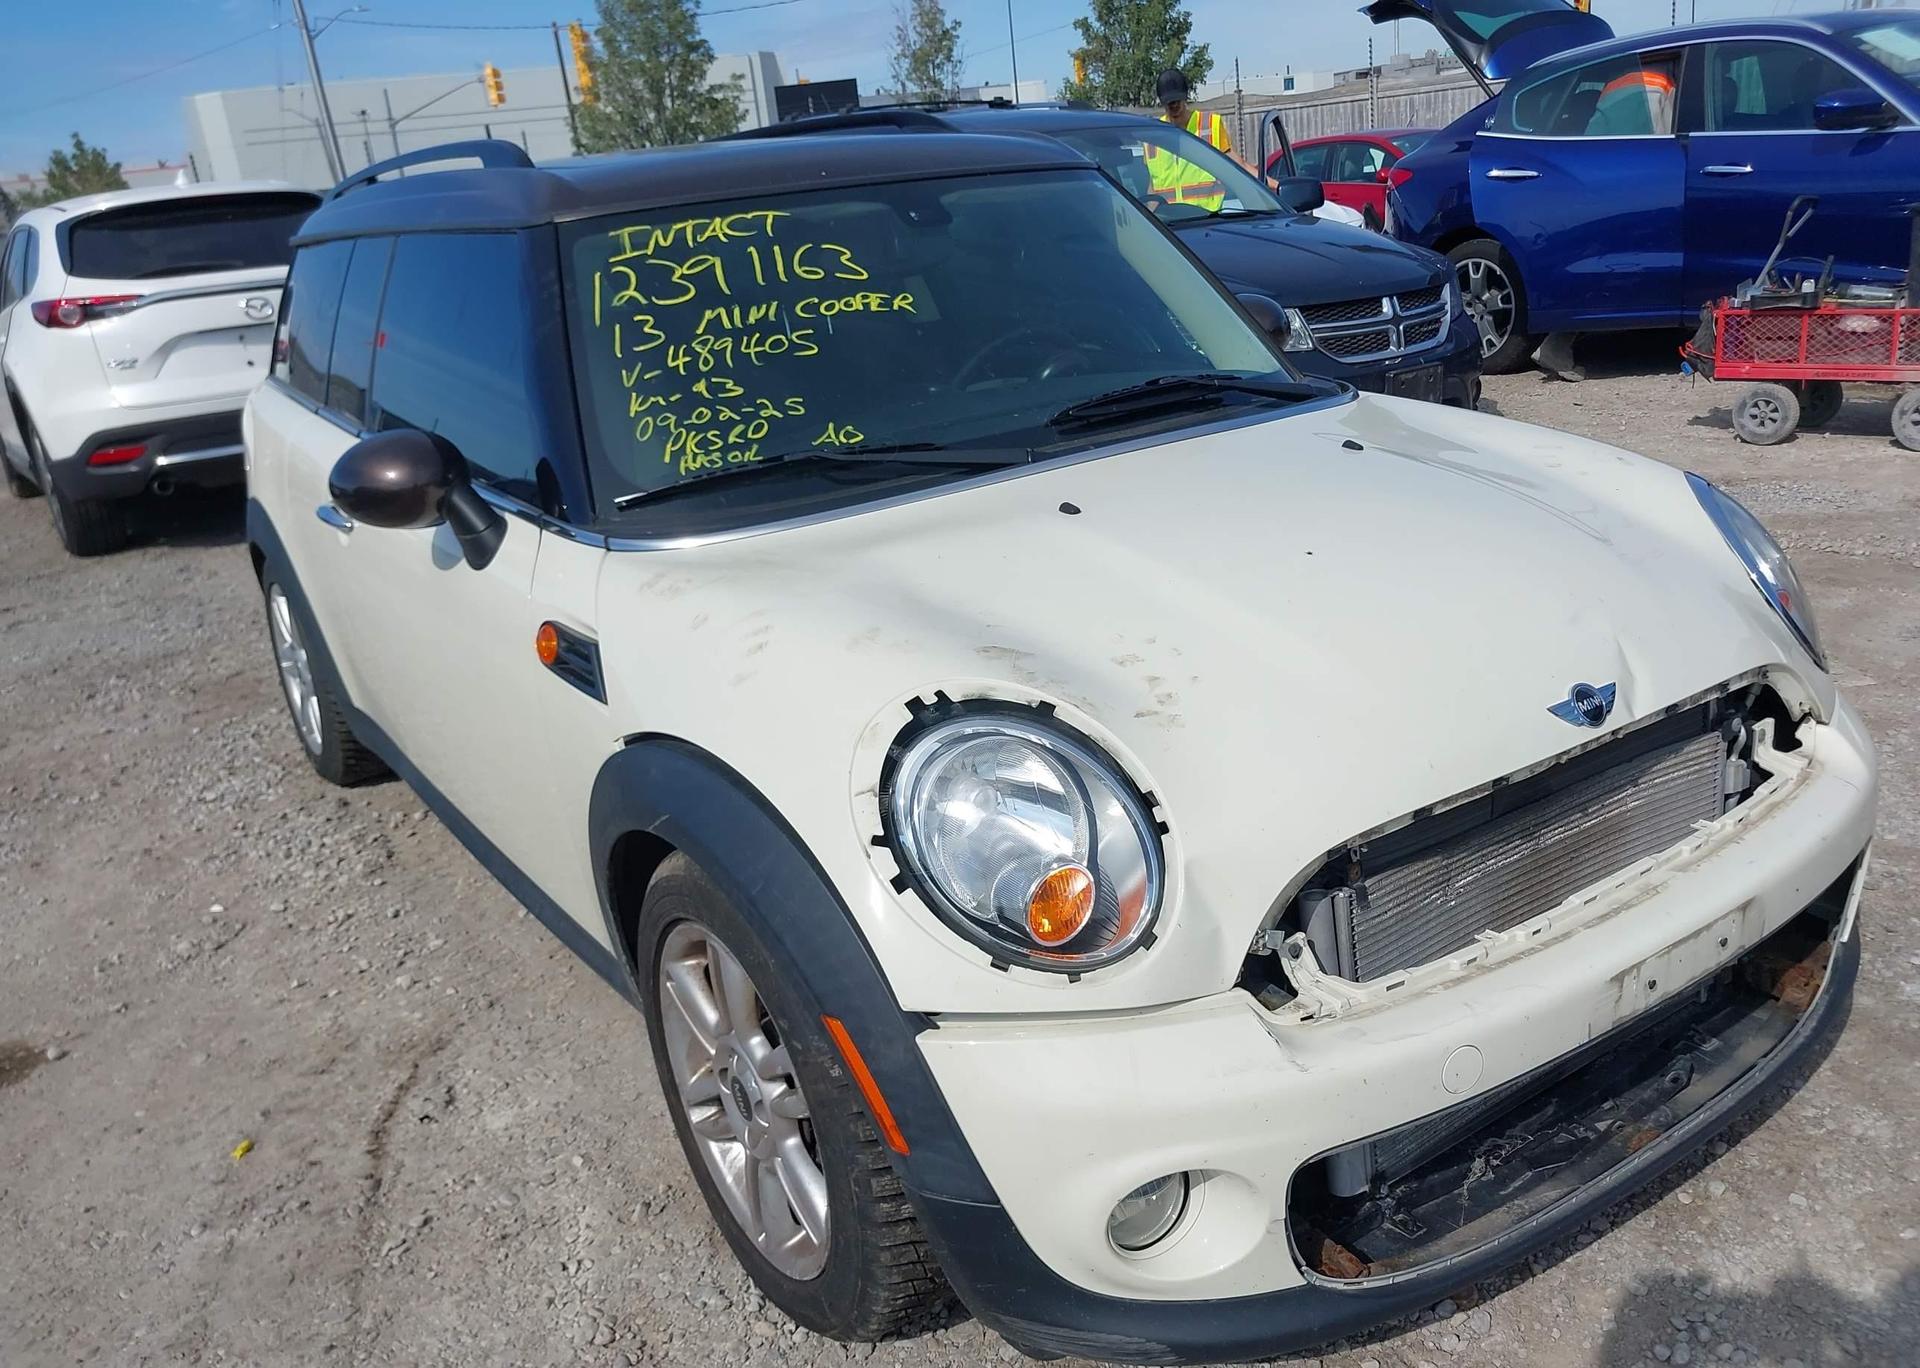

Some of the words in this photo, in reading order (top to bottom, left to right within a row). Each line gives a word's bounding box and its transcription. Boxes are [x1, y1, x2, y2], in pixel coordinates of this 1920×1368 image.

[608, 210, 792, 264] INTACT
[614, 314, 666, 358] 13
[696, 300, 779, 335] MINI
[794, 291, 917, 318] COOPER
[1578, 695, 1601, 713] MINI
